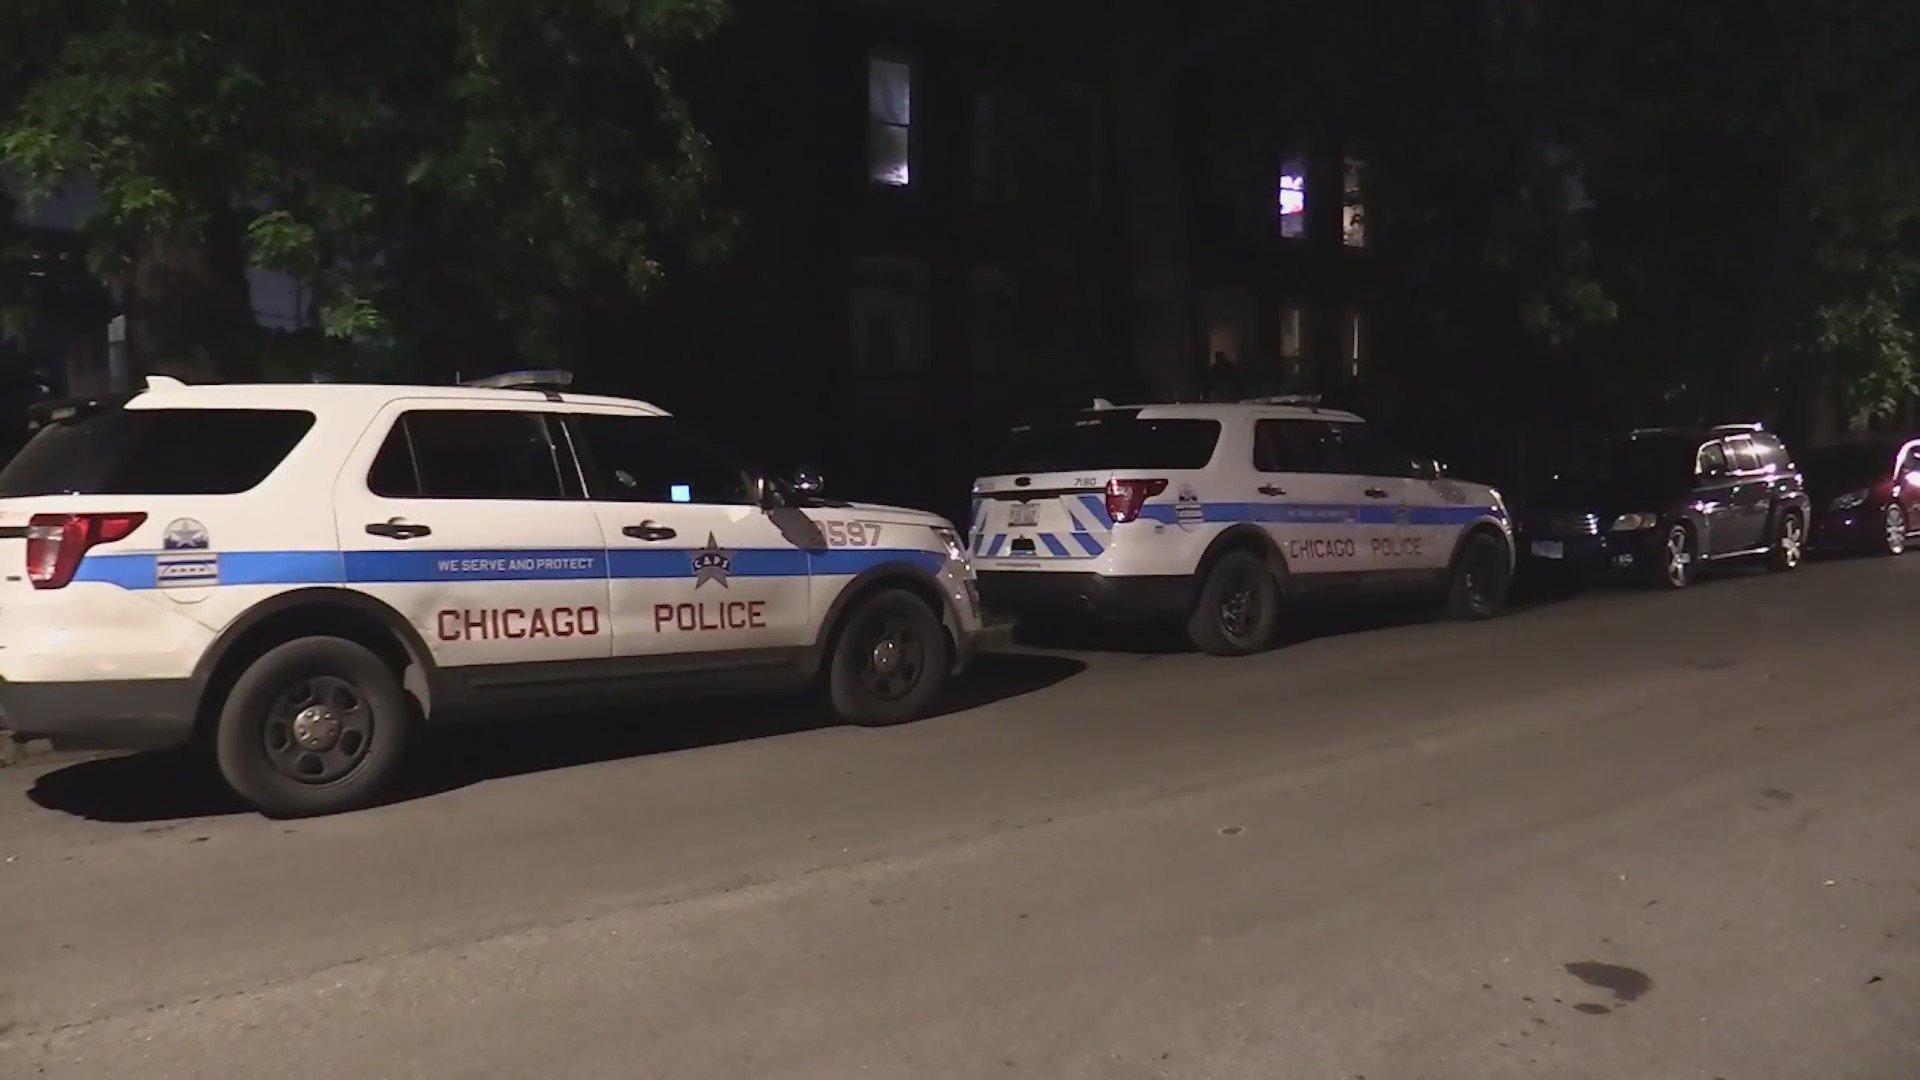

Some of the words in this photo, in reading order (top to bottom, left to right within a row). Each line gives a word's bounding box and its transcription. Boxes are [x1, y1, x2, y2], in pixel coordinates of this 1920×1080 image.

[1290, 538, 1355, 559] CHICAGO
[1372, 538, 1423, 557] POLICE
[438, 560, 459, 572] WE
[461, 559, 506, 572] SERVE
[508, 558, 534, 571] AND
[536, 557, 594, 570] PROTECT
[693, 555, 729, 569] CAPS
[438, 606, 599, 641] CHICAGO
[654, 601, 767, 633] POLICE
